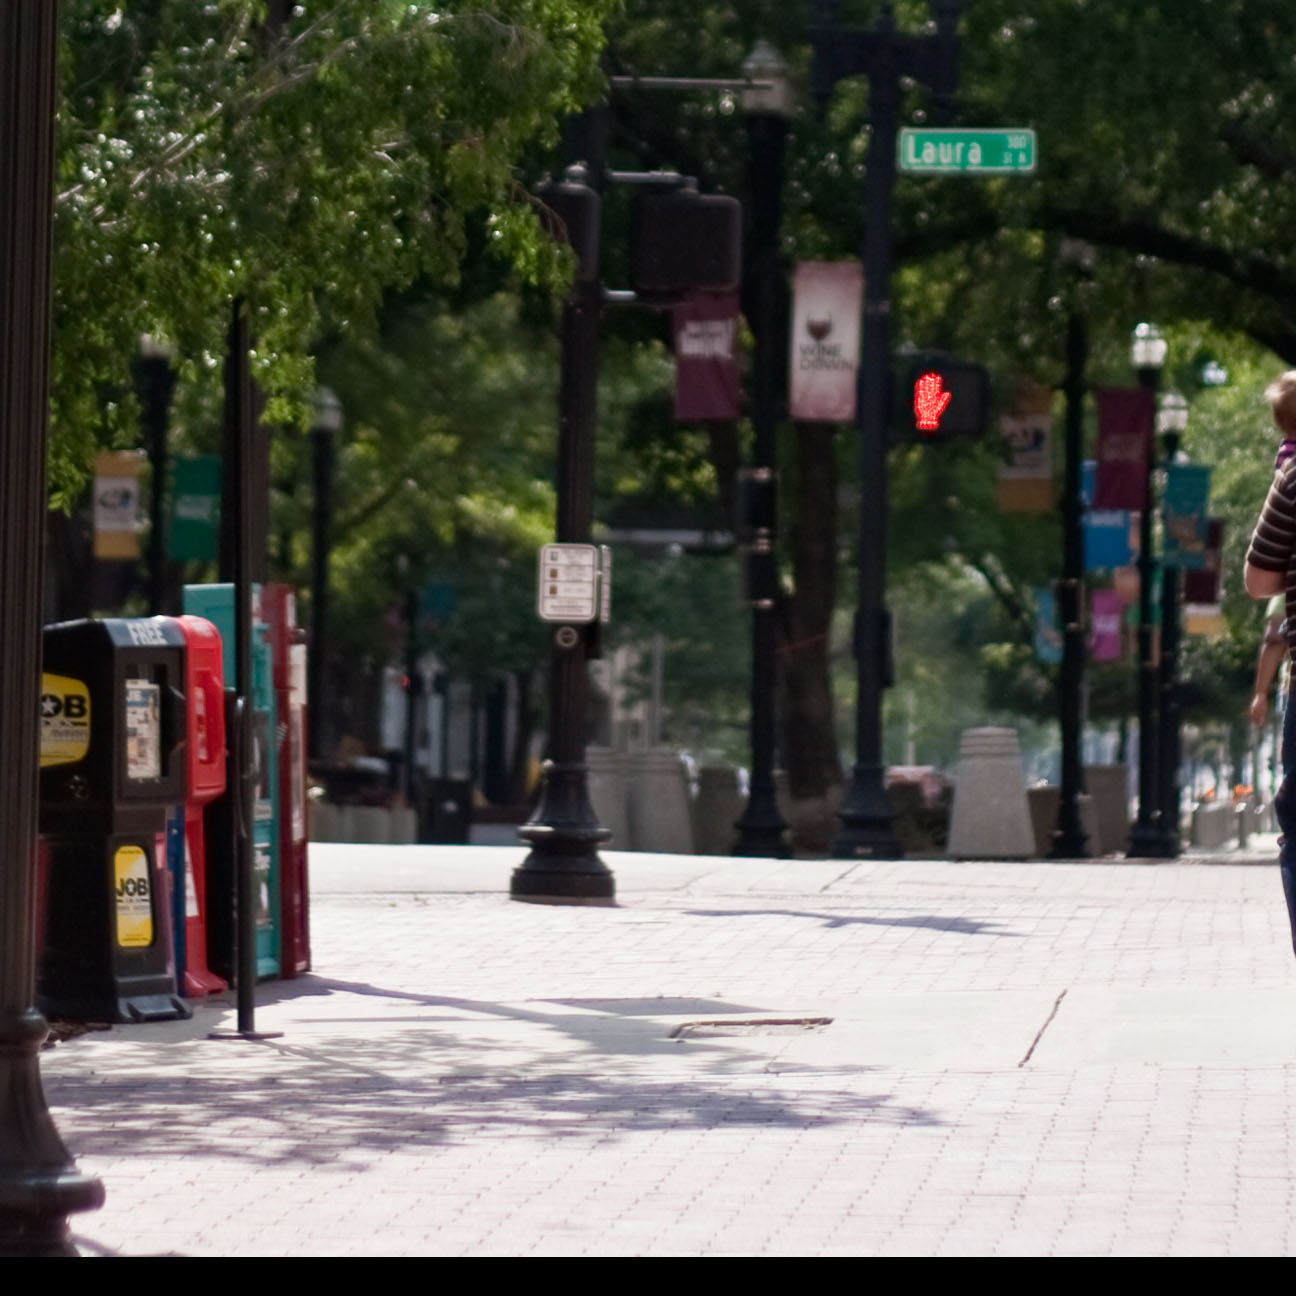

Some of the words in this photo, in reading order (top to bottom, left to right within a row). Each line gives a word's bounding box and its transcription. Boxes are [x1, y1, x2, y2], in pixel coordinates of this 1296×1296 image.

[907, 134, 982, 164] Laura
[126, 619, 169, 646] FREE
[41, 693, 87, 718] OB
[115, 877, 148, 897] JOB
